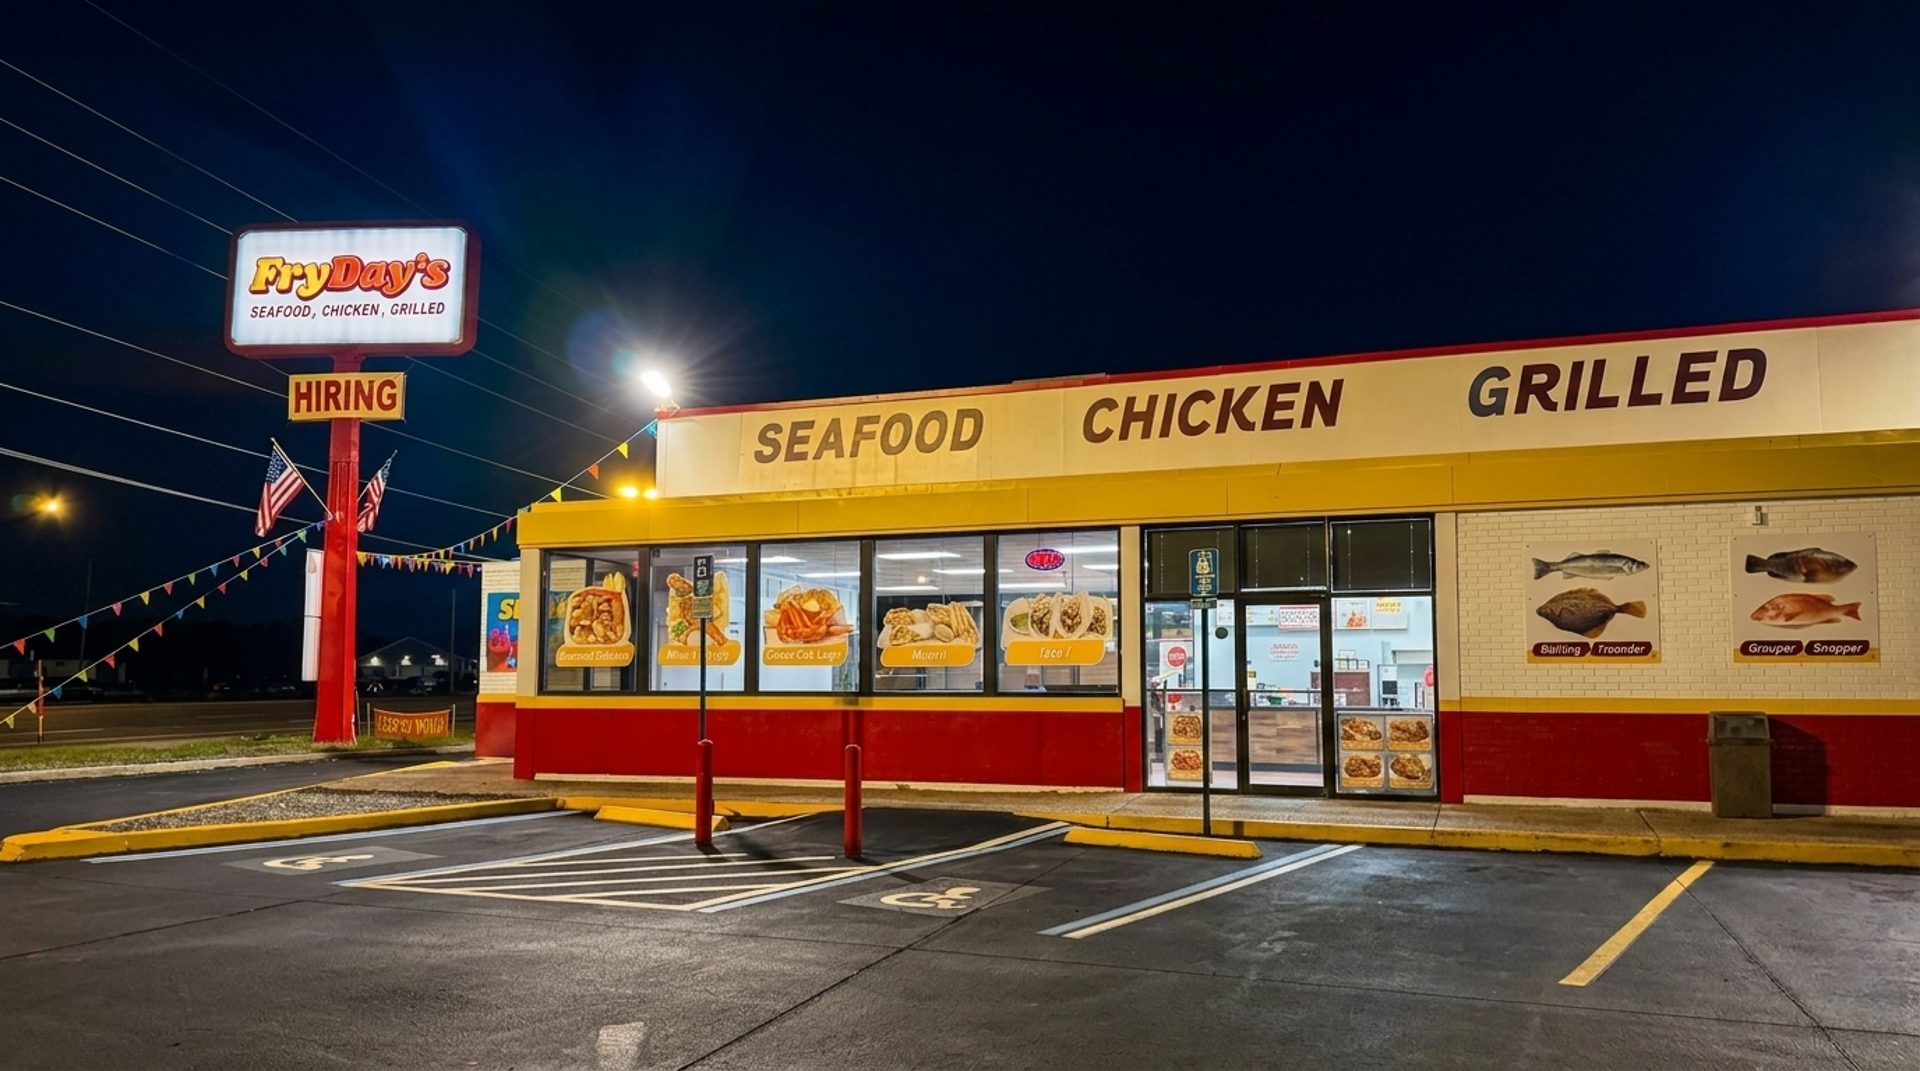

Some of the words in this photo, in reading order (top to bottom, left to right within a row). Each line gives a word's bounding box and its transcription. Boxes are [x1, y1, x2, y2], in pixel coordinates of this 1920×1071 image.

[249, 252, 451, 301] FryDay's
[250, 305, 316, 319] SEAFOOD,
[390, 302, 445, 315] GRILLED
[293, 378, 397, 414] HIRING
[1468, 348, 1768, 418] GRILLED
[1082, 378, 1345, 444] CHICKEN
[754, 408, 984, 464] SEAFOOD
[1748, 643, 1797, 655] Grouper
